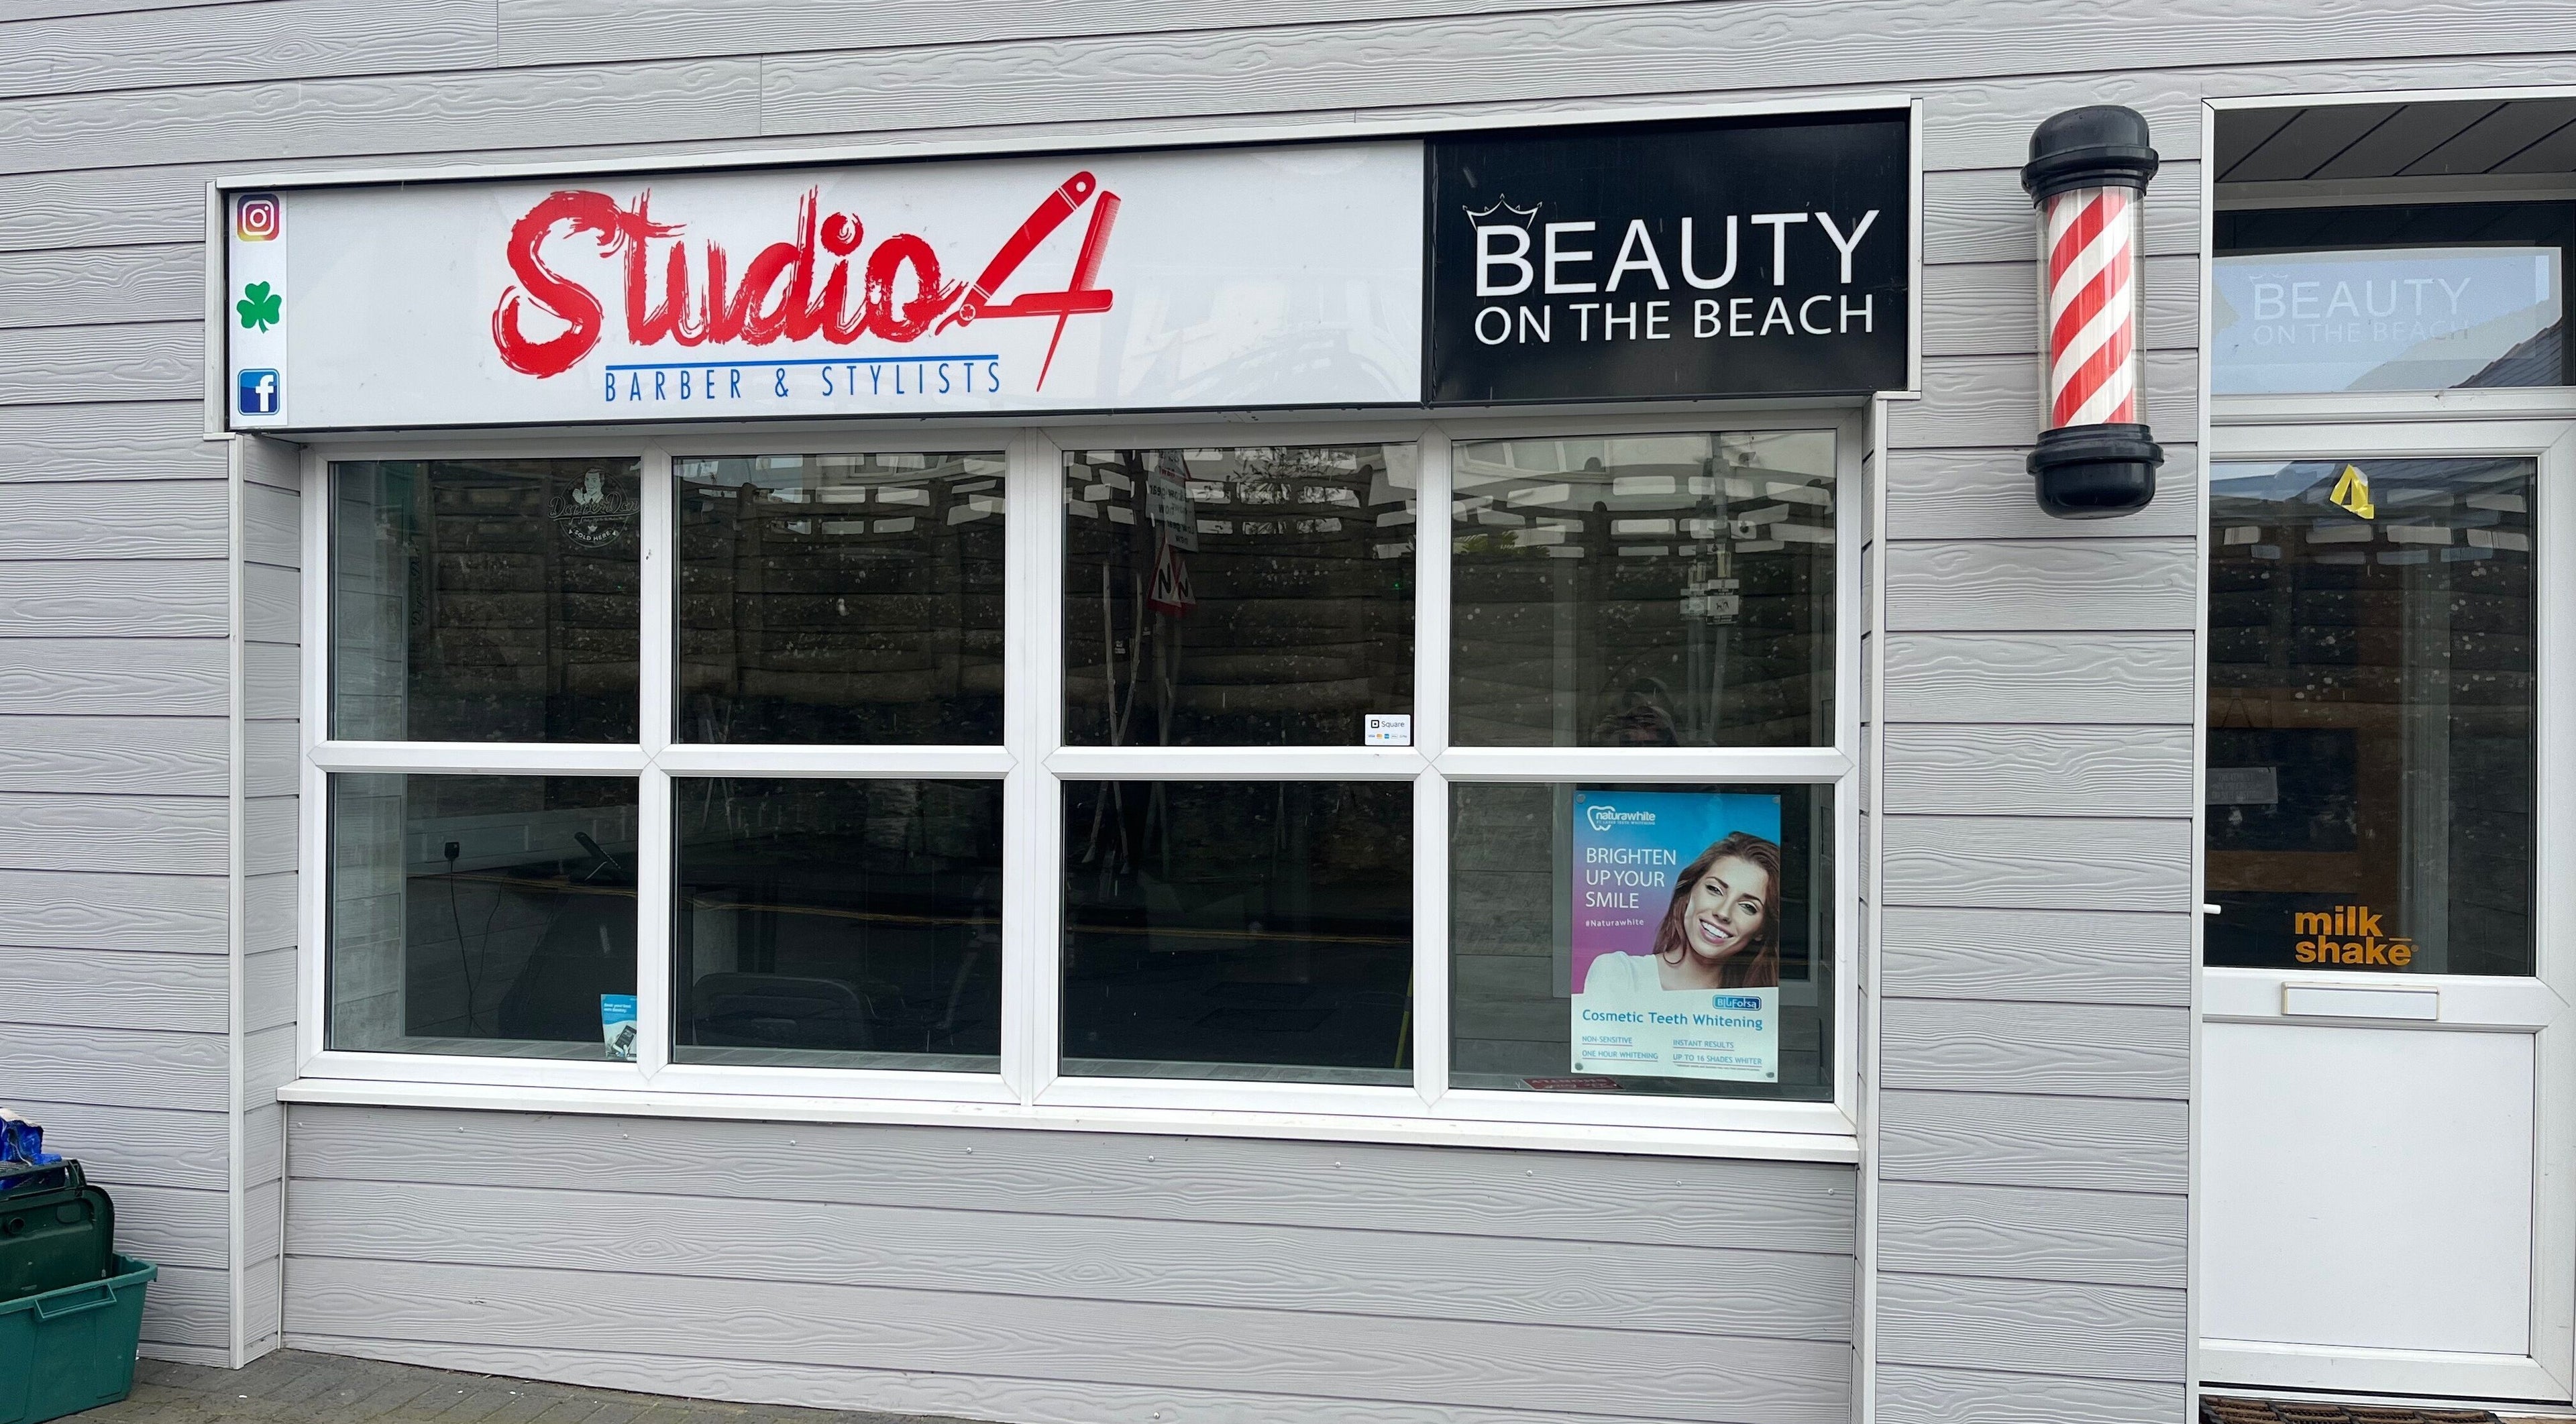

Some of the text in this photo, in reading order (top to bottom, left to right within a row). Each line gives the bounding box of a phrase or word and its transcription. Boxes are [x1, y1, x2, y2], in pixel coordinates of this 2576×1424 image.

[1476, 209, 1880, 297] BEAUTY
[492, 184, 967, 378] Studio
[2253, 277, 2471, 321] BEAUTY
[1474, 294, 1873, 345] ON THE BEACH
[2253, 319, 2469, 346] ON THE BEACH
[606, 362, 1001, 402] BARBER & STYLISTS
[574, 529, 611, 541] SOLD HERE
[1595, 810, 1656, 822] naturawhite
[1586, 848, 1676, 866] BRIGHTEN
[1586, 870, 1665, 887] UP YOUR
[1585, 892, 1640, 909] SMILE
[1585, 918, 1644, 928] #Naturawhite
[1582, 1009, 1763, 1031] Cosmetic Teeth Whitening
[1673, 1039, 1734, 1048] INSTANT RESULTS
[1619, 1052, 1658, 1060] WHITENING
[1707, 1056, 1733, 1064] SHADES
[1735, 1057, 1763, 1065] WHITER
